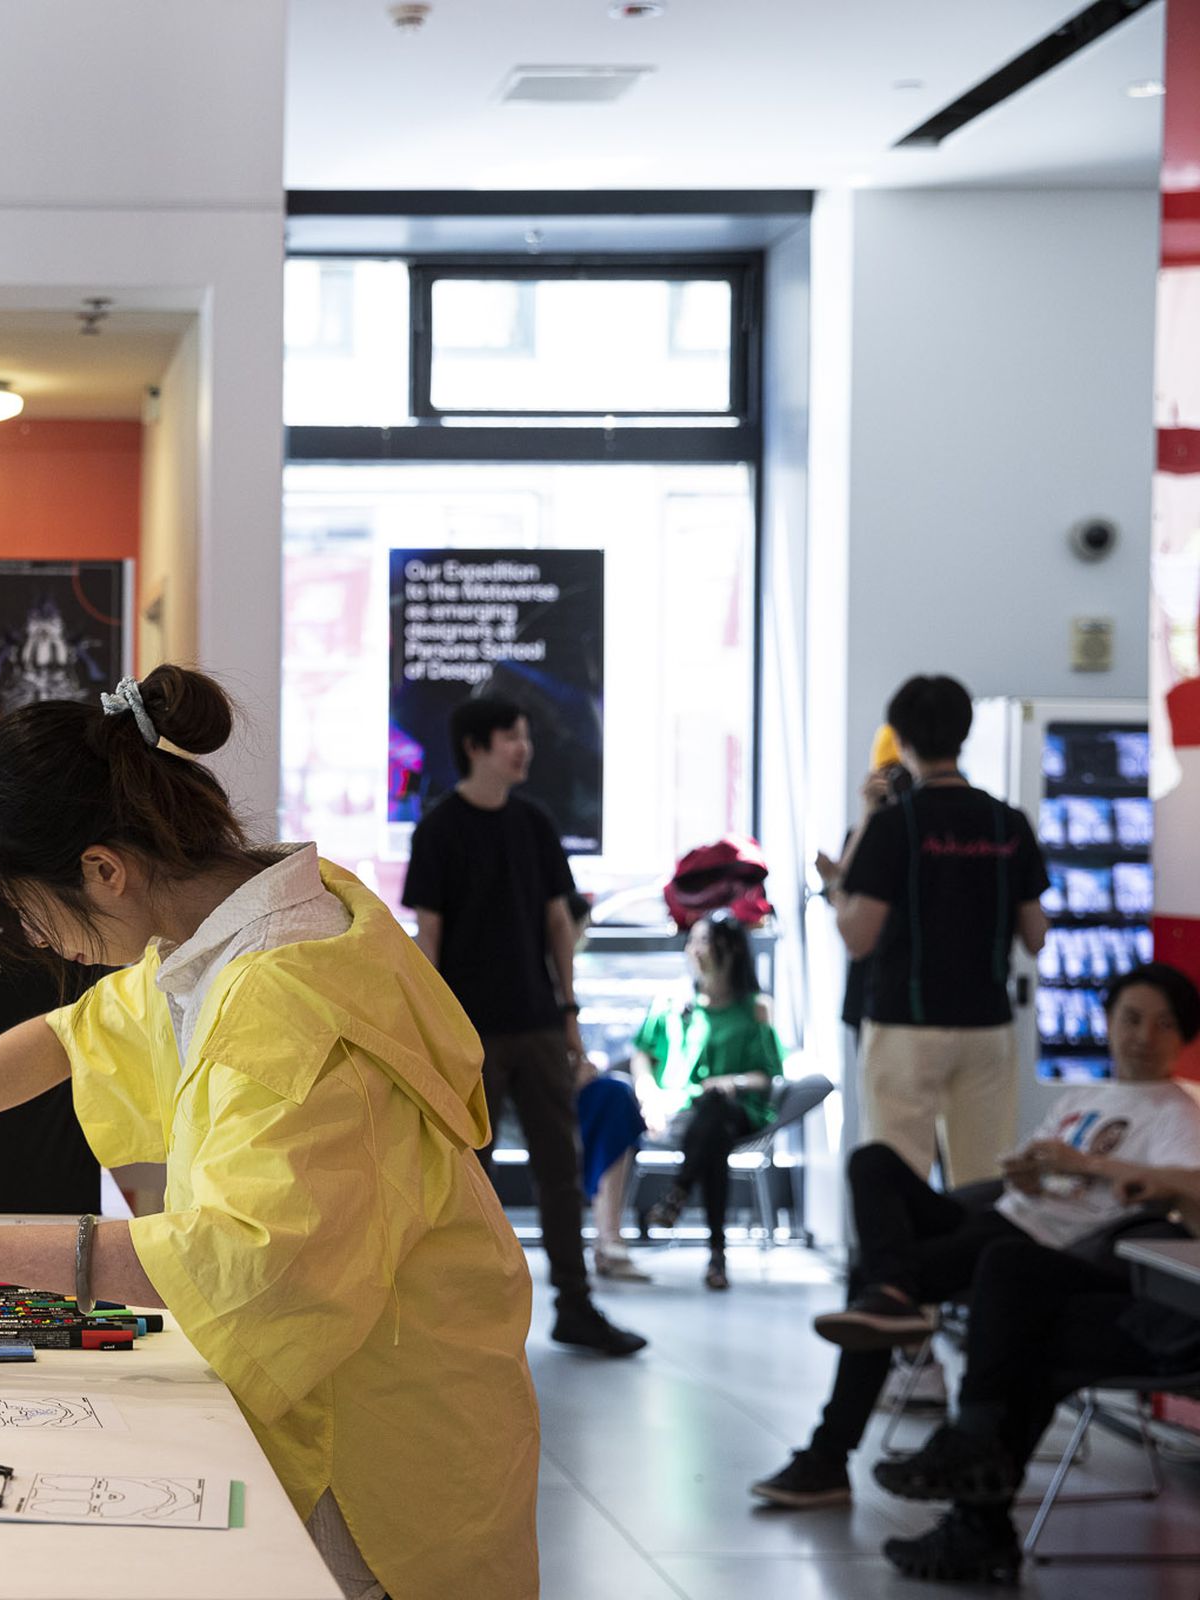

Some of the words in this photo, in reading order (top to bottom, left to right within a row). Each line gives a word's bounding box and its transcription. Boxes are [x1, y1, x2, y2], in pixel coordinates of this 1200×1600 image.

[405, 559, 441, 582] Our
[405, 583, 427, 601] to
[428, 583, 460, 601] the
[461, 582, 559, 602] Metaverse
[429, 603, 518, 625] emerging
[405, 640, 479, 661] Parsons
[479, 640, 546, 661] School
[405, 662, 425, 680] of
[427, 661, 493, 684] Design
